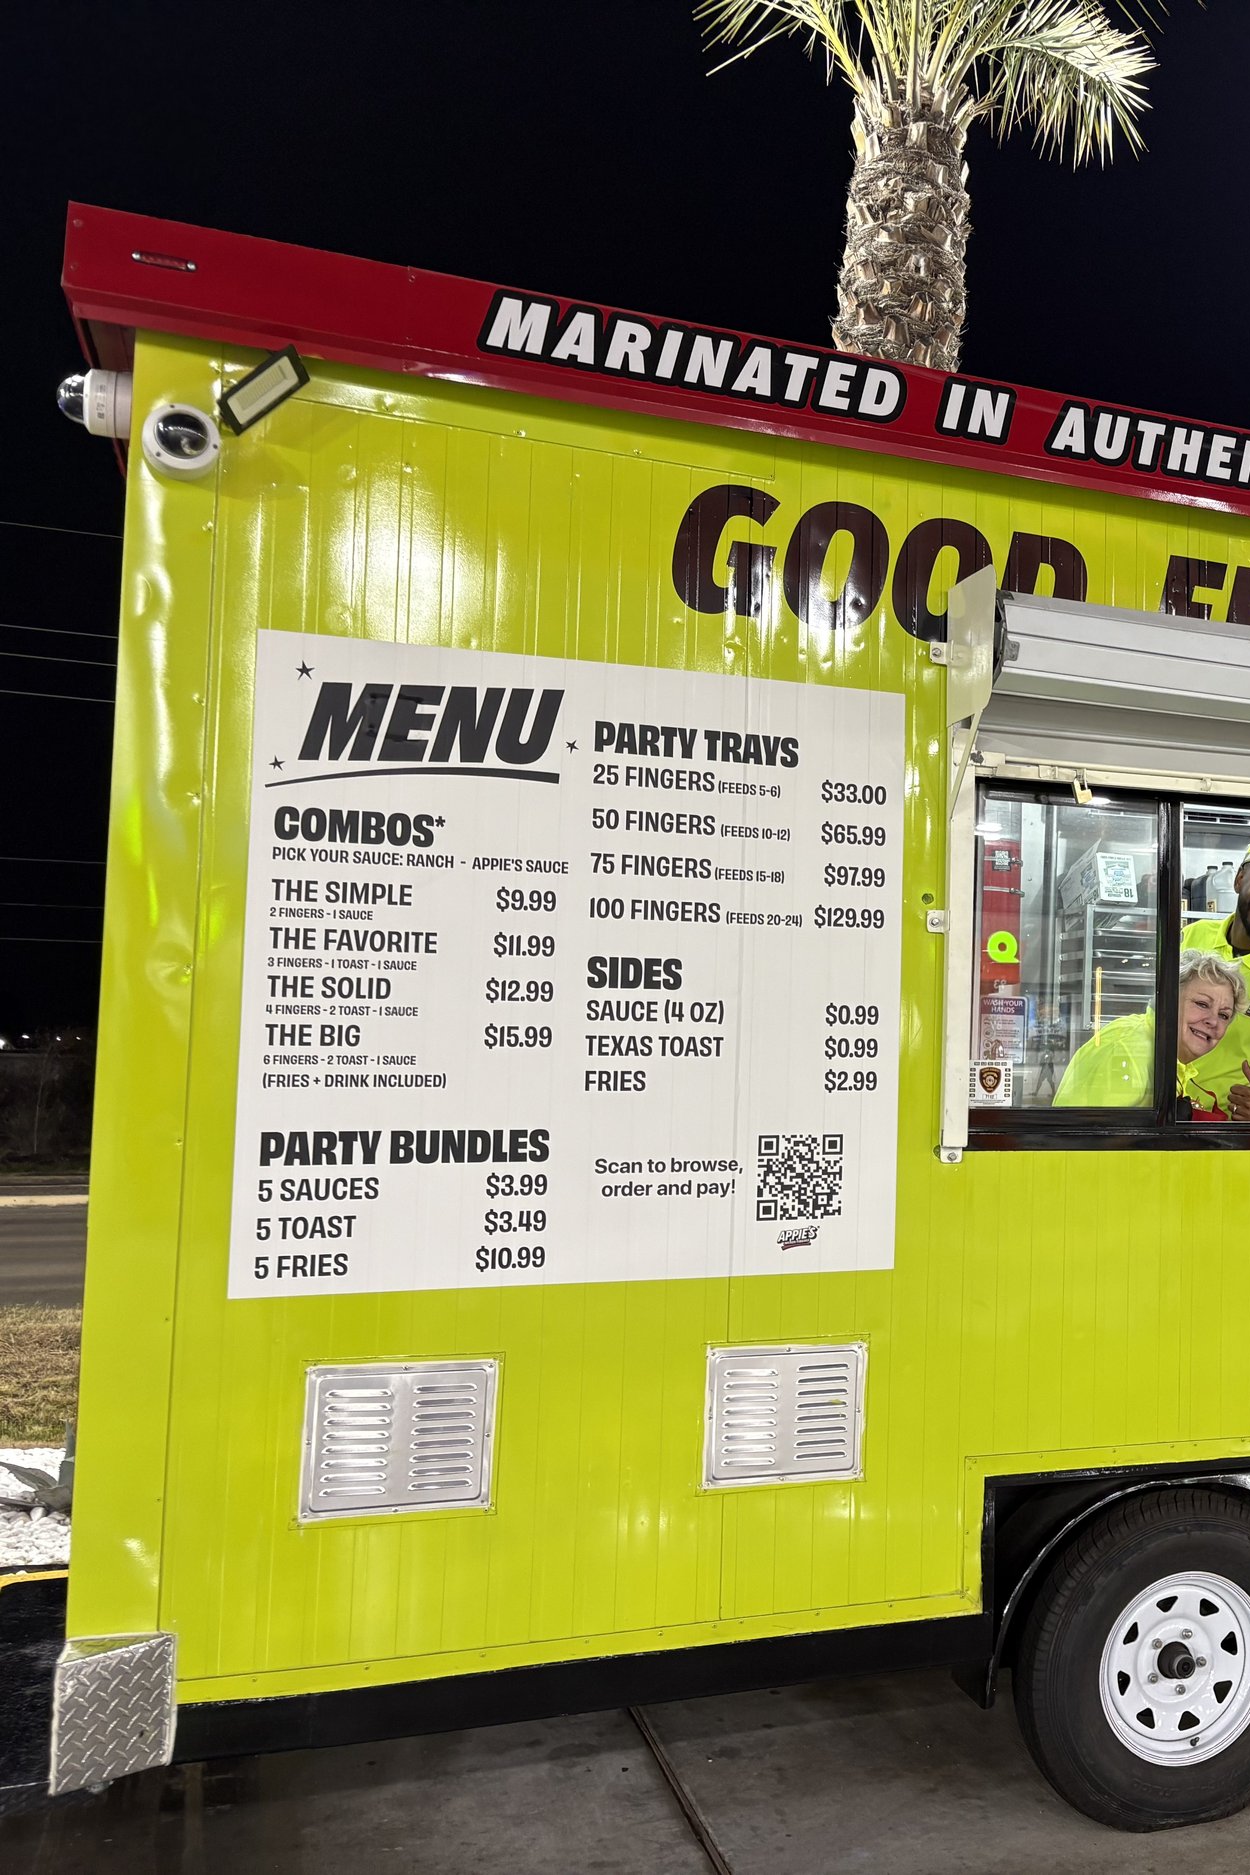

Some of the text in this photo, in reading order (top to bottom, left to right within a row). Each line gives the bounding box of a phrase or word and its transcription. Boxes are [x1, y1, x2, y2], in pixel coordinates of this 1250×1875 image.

[485, 297, 901, 418] MARINATED
[942, 384, 1010, 438] IN
[671, 484, 1088, 643] GOOD
[298, 682, 565, 764] MENU
[594, 720, 799, 768] PARTY TRAYS
[593, 764, 887, 805] 25 FINGERS (FEEDS 5-6) $33.00
[592, 808, 886, 846] 50 FINGERS (FEEDS 10-12) $65.99
[273, 847, 569, 874] PICK YOUR SAUCE: RANCH APPIE'S SAUCE
[591, 852, 886, 888] 75 FINGERS (FEEDS 15-18) $97.99
[272, 879, 556, 912] THE SIMPLE $9.99
[278, 908, 324, 919] FINGERS
[338, 910, 373, 920] SAUCE
[589, 897, 884, 929] 100 FINGERS (FEEDS 20-24) $129.99
[269, 927, 555, 957] THE FAVORITE $11.99
[277, 958, 322, 968] FINGERS
[337, 959, 369, 970] TOAST
[383, 959, 417, 971] SAUCE
[586, 956, 682, 991] SIDES
[268, 975, 554, 1003] THE SOLID $12.99
[275, 1005, 321, 1015] FINGERS
[338, 1005, 371, 1016] TOAST
[384, 1006, 418, 1017] SAUCE
[586, 999, 879, 1026] SAUCE (4 OZ) $0.99
[266, 1023, 552, 1049] THE BIG $15.99
[585, 1035, 878, 1060] TEXAS TOAST $0.99
[273, 1055, 319, 1065] FINGERS
[336, 1055, 368, 1065] TOAST
[382, 1055, 416, 1066] SAUCE
[262, 1073, 309, 1089] (FRIES
[325, 1075, 369, 1087] DRINK
[373, 1074, 446, 1089] INCLUDED)
[585, 1069, 878, 1093] FRIES $2.99
[259, 1129, 549, 1166] PARTY BUNDLES
[594, 1157, 743, 1174] Scan to browse,
[258, 1173, 548, 1202] 5 SAUCES $3.99
[601, 1179, 735, 1198] order and pay!
[257, 1209, 546, 1241] 5 TOAST $3.49
[254, 1245, 545, 1279] 5 FRIES $10.99
